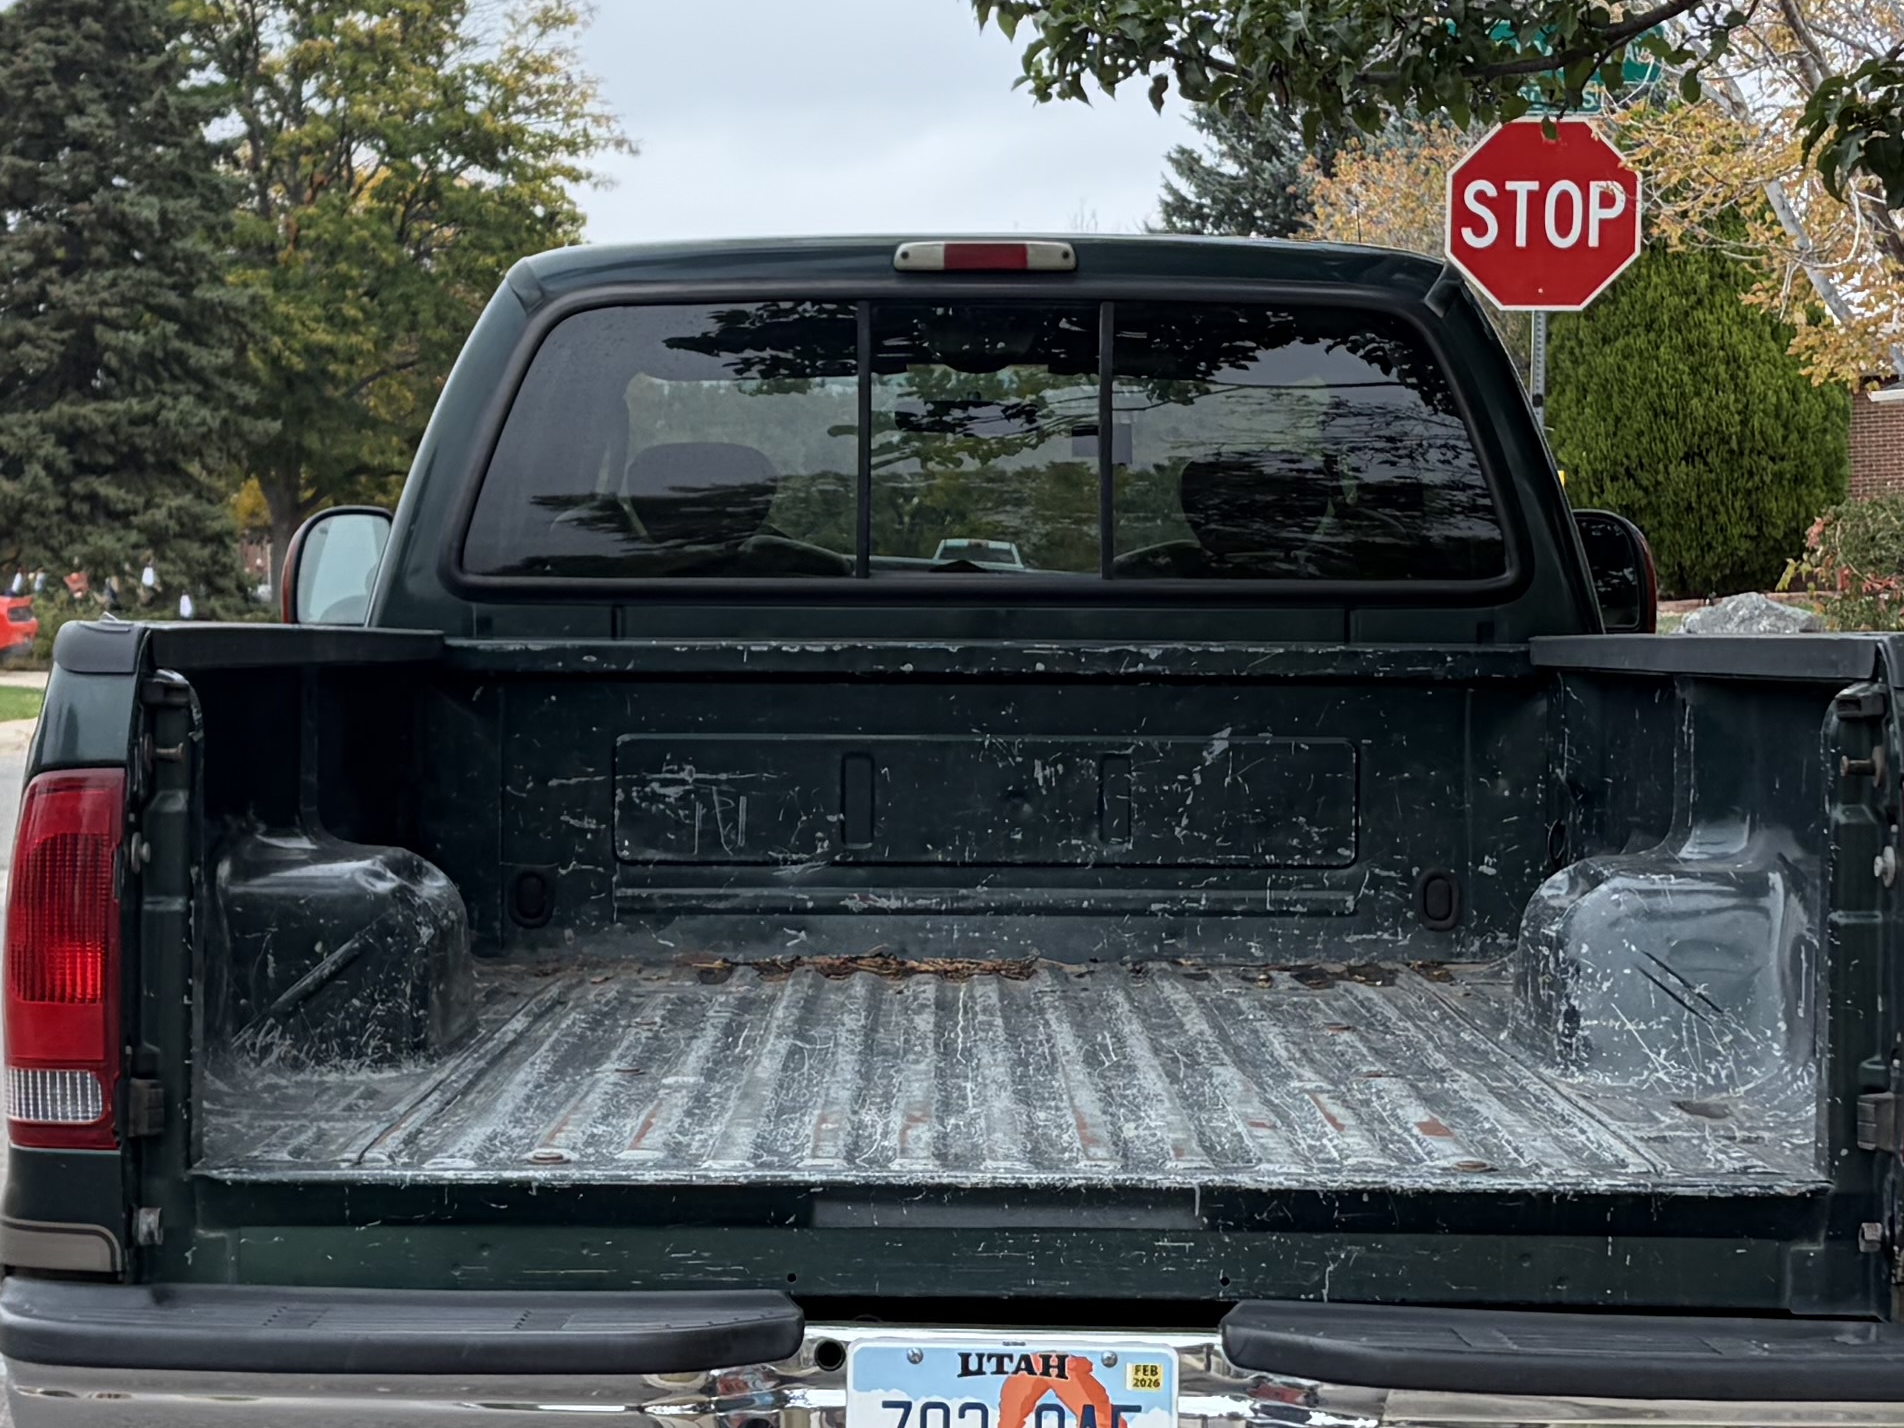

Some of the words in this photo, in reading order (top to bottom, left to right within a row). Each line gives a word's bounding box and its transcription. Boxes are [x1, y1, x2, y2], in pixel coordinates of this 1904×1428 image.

[1460, 179, 1626, 249] STOP
[957, 1351, 1070, 1380] UTAH
[1134, 1364, 1159, 1376] FEB
[1132, 1378, 1161, 1389] 2026
